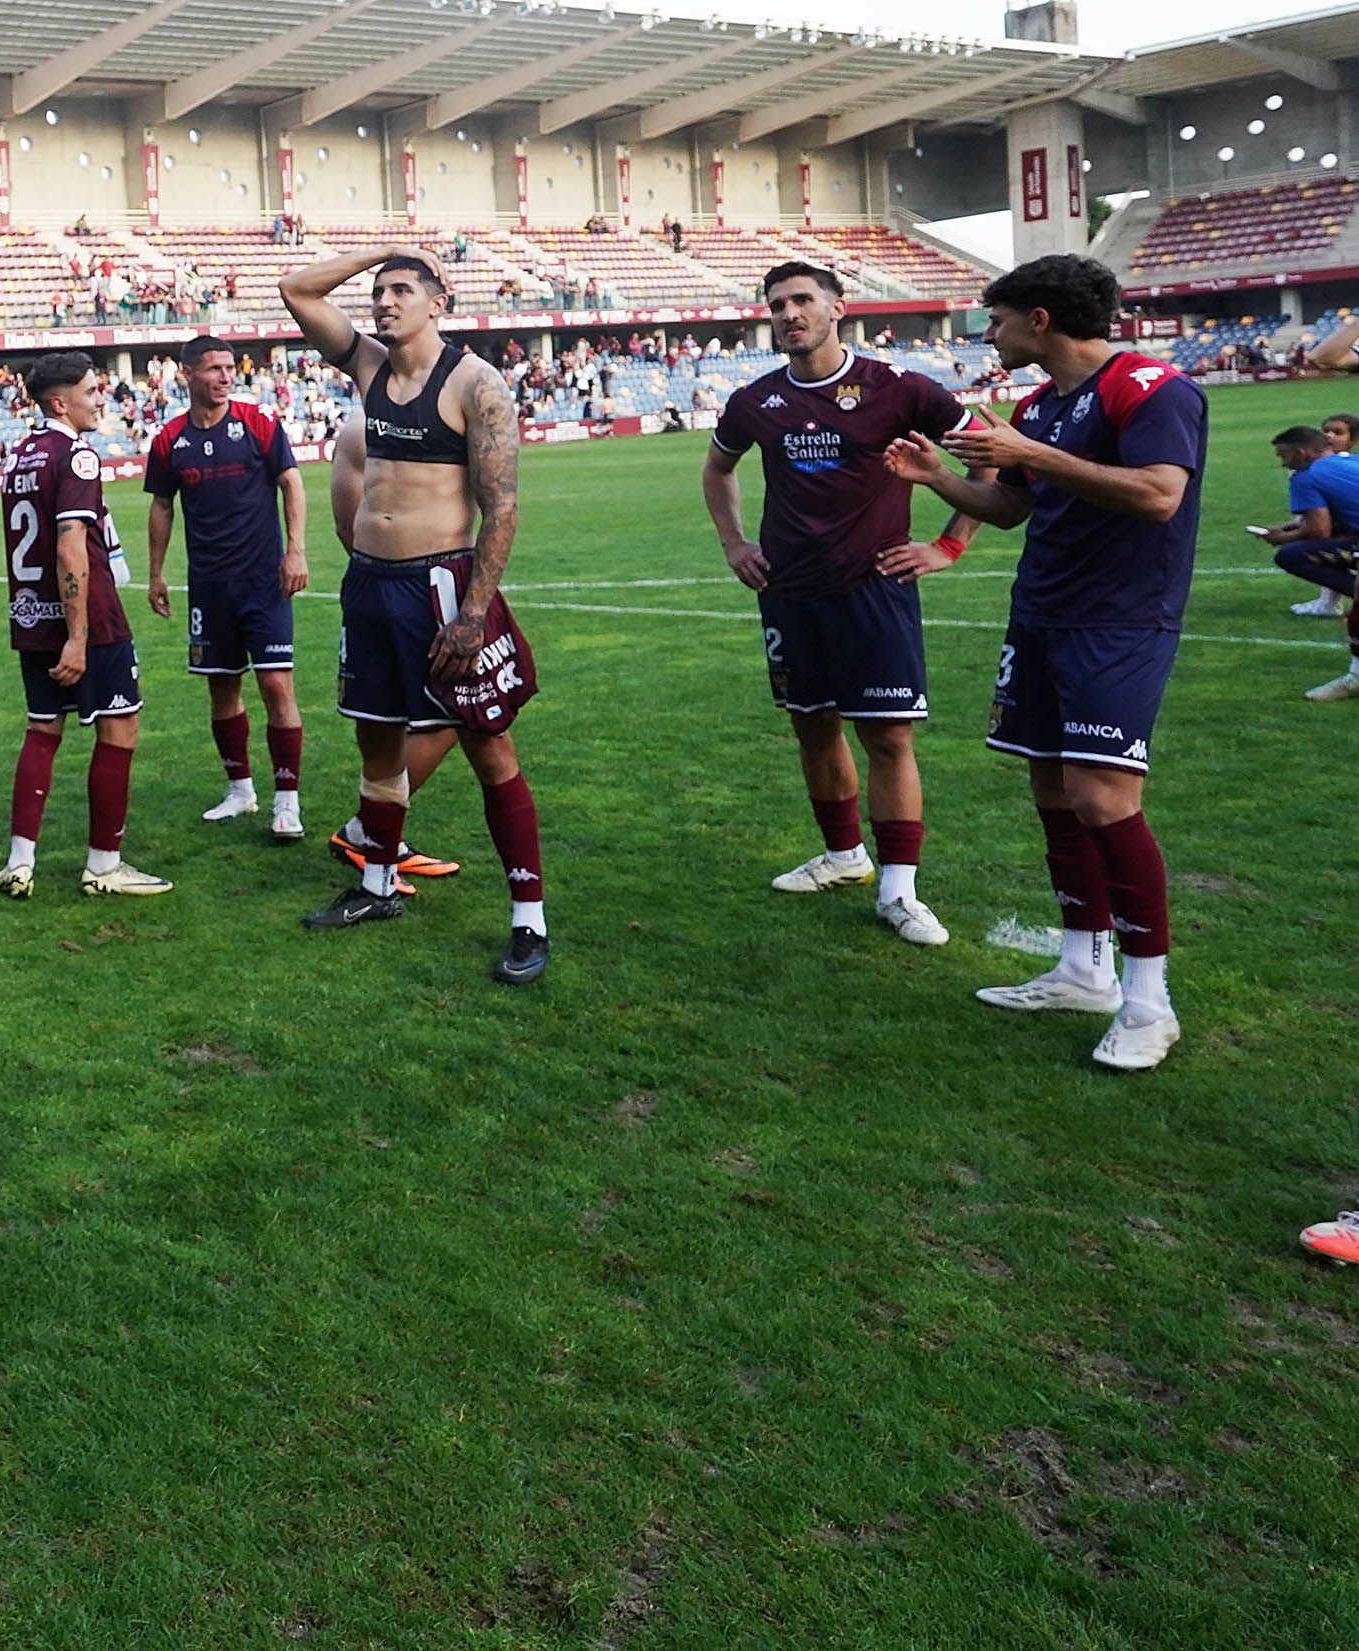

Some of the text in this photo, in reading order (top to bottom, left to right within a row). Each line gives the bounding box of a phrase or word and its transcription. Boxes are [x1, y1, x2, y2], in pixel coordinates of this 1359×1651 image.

[783, 432, 841, 447] Estrella
[204, 441, 214, 456] 8
[786, 445, 840, 460] Galicia
[10, 499, 43, 582] 2
[191, 607, 202, 635] 8
[1063, 721, 1124, 740] ABANCA
